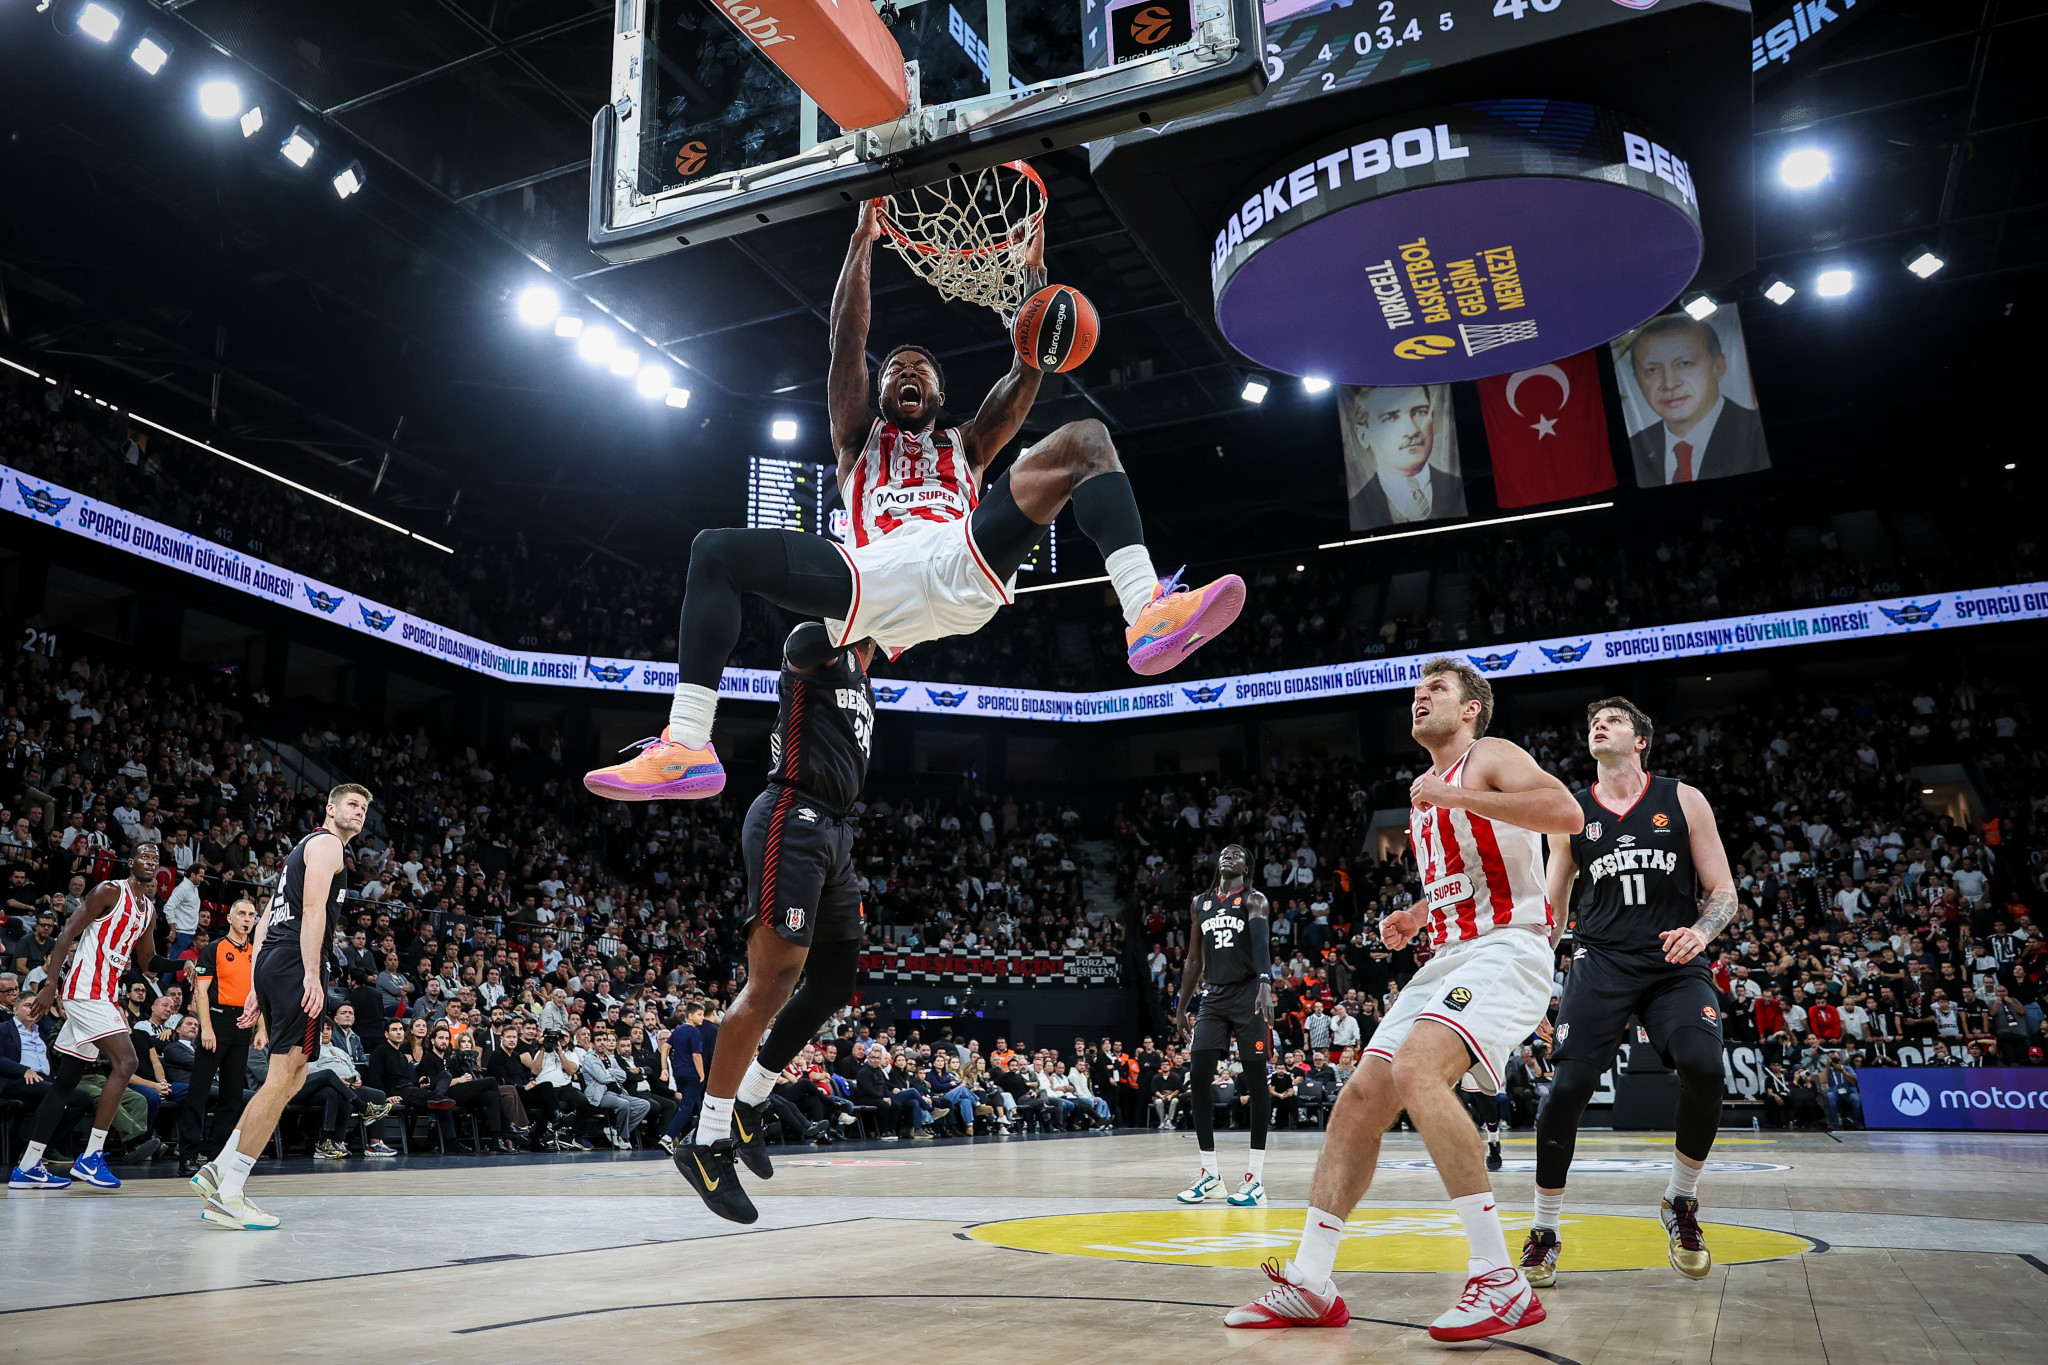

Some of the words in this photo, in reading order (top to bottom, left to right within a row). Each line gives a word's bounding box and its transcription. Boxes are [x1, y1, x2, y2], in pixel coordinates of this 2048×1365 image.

[1353, 17, 1422, 55] 03.4
[1438, 11, 1454, 31] 5
[1317, 43, 1332, 61] 4
[1321, 72, 1336, 91] 2
[1215, 123, 1470, 273] BASKETBOL
[1365, 259, 1415, 330] TURKCELL
[1398, 236, 1452, 325] BASKETBOL
[1442, 259, 1489, 317] GELİŞİM
[1475, 245, 1527, 311] MERKEZİ
[1020, 298, 1046, 358] SPALDING
[1048, 303, 1067, 355] EuroLeague
[918, 490, 955, 505] SUPER
[78, 506, 132, 543] SPORCU
[132, 526, 193, 565] GIDASININ
[195, 547, 252, 586] GÜVENİLİR
[253, 570, 294, 600] ADRESİ!
[1954, 595, 2021, 619] SPORCU
[22, 627, 57, 658] 211
[402, 622, 438, 649] SPORCU
[438, 635, 481, 664] GIDASININ
[480, 646, 529, 676] GÜVENİLİR
[530, 659, 578, 681] ADRESİ!
[1605, 638, 1661, 659] SPORCU
[1662, 628, 1733, 653] GIDASININ
[1734, 616, 1810, 643] GÜVENİLİR
[1811, 609, 1871, 635] ADRESİ!
[1235, 678, 1283, 700] SPORCU
[1284, 672, 1344, 694] GIDASININ
[1345, 663, 1407, 688] GÜVENİLİR
[977, 694, 1020, 712] SPORCU
[1021, 697, 1074, 716] GIDASININ
[1075, 692, 1131, 716] GÜVENİLİR
[1132, 690, 1174, 710] ADRESİ!
[1588, 848, 1677, 886] BEŞİKTAŞ
[1433, 880, 1463, 902] SUPER
[1619, 873, 1646, 906] 11
[1213, 928, 1234, 950] 32
[904, 954, 1008, 976] BEŞİKTAŞ
[1069, 966, 1115, 977] BEŞİKTAŞ
[1075, 957, 1108, 968] FORZA
